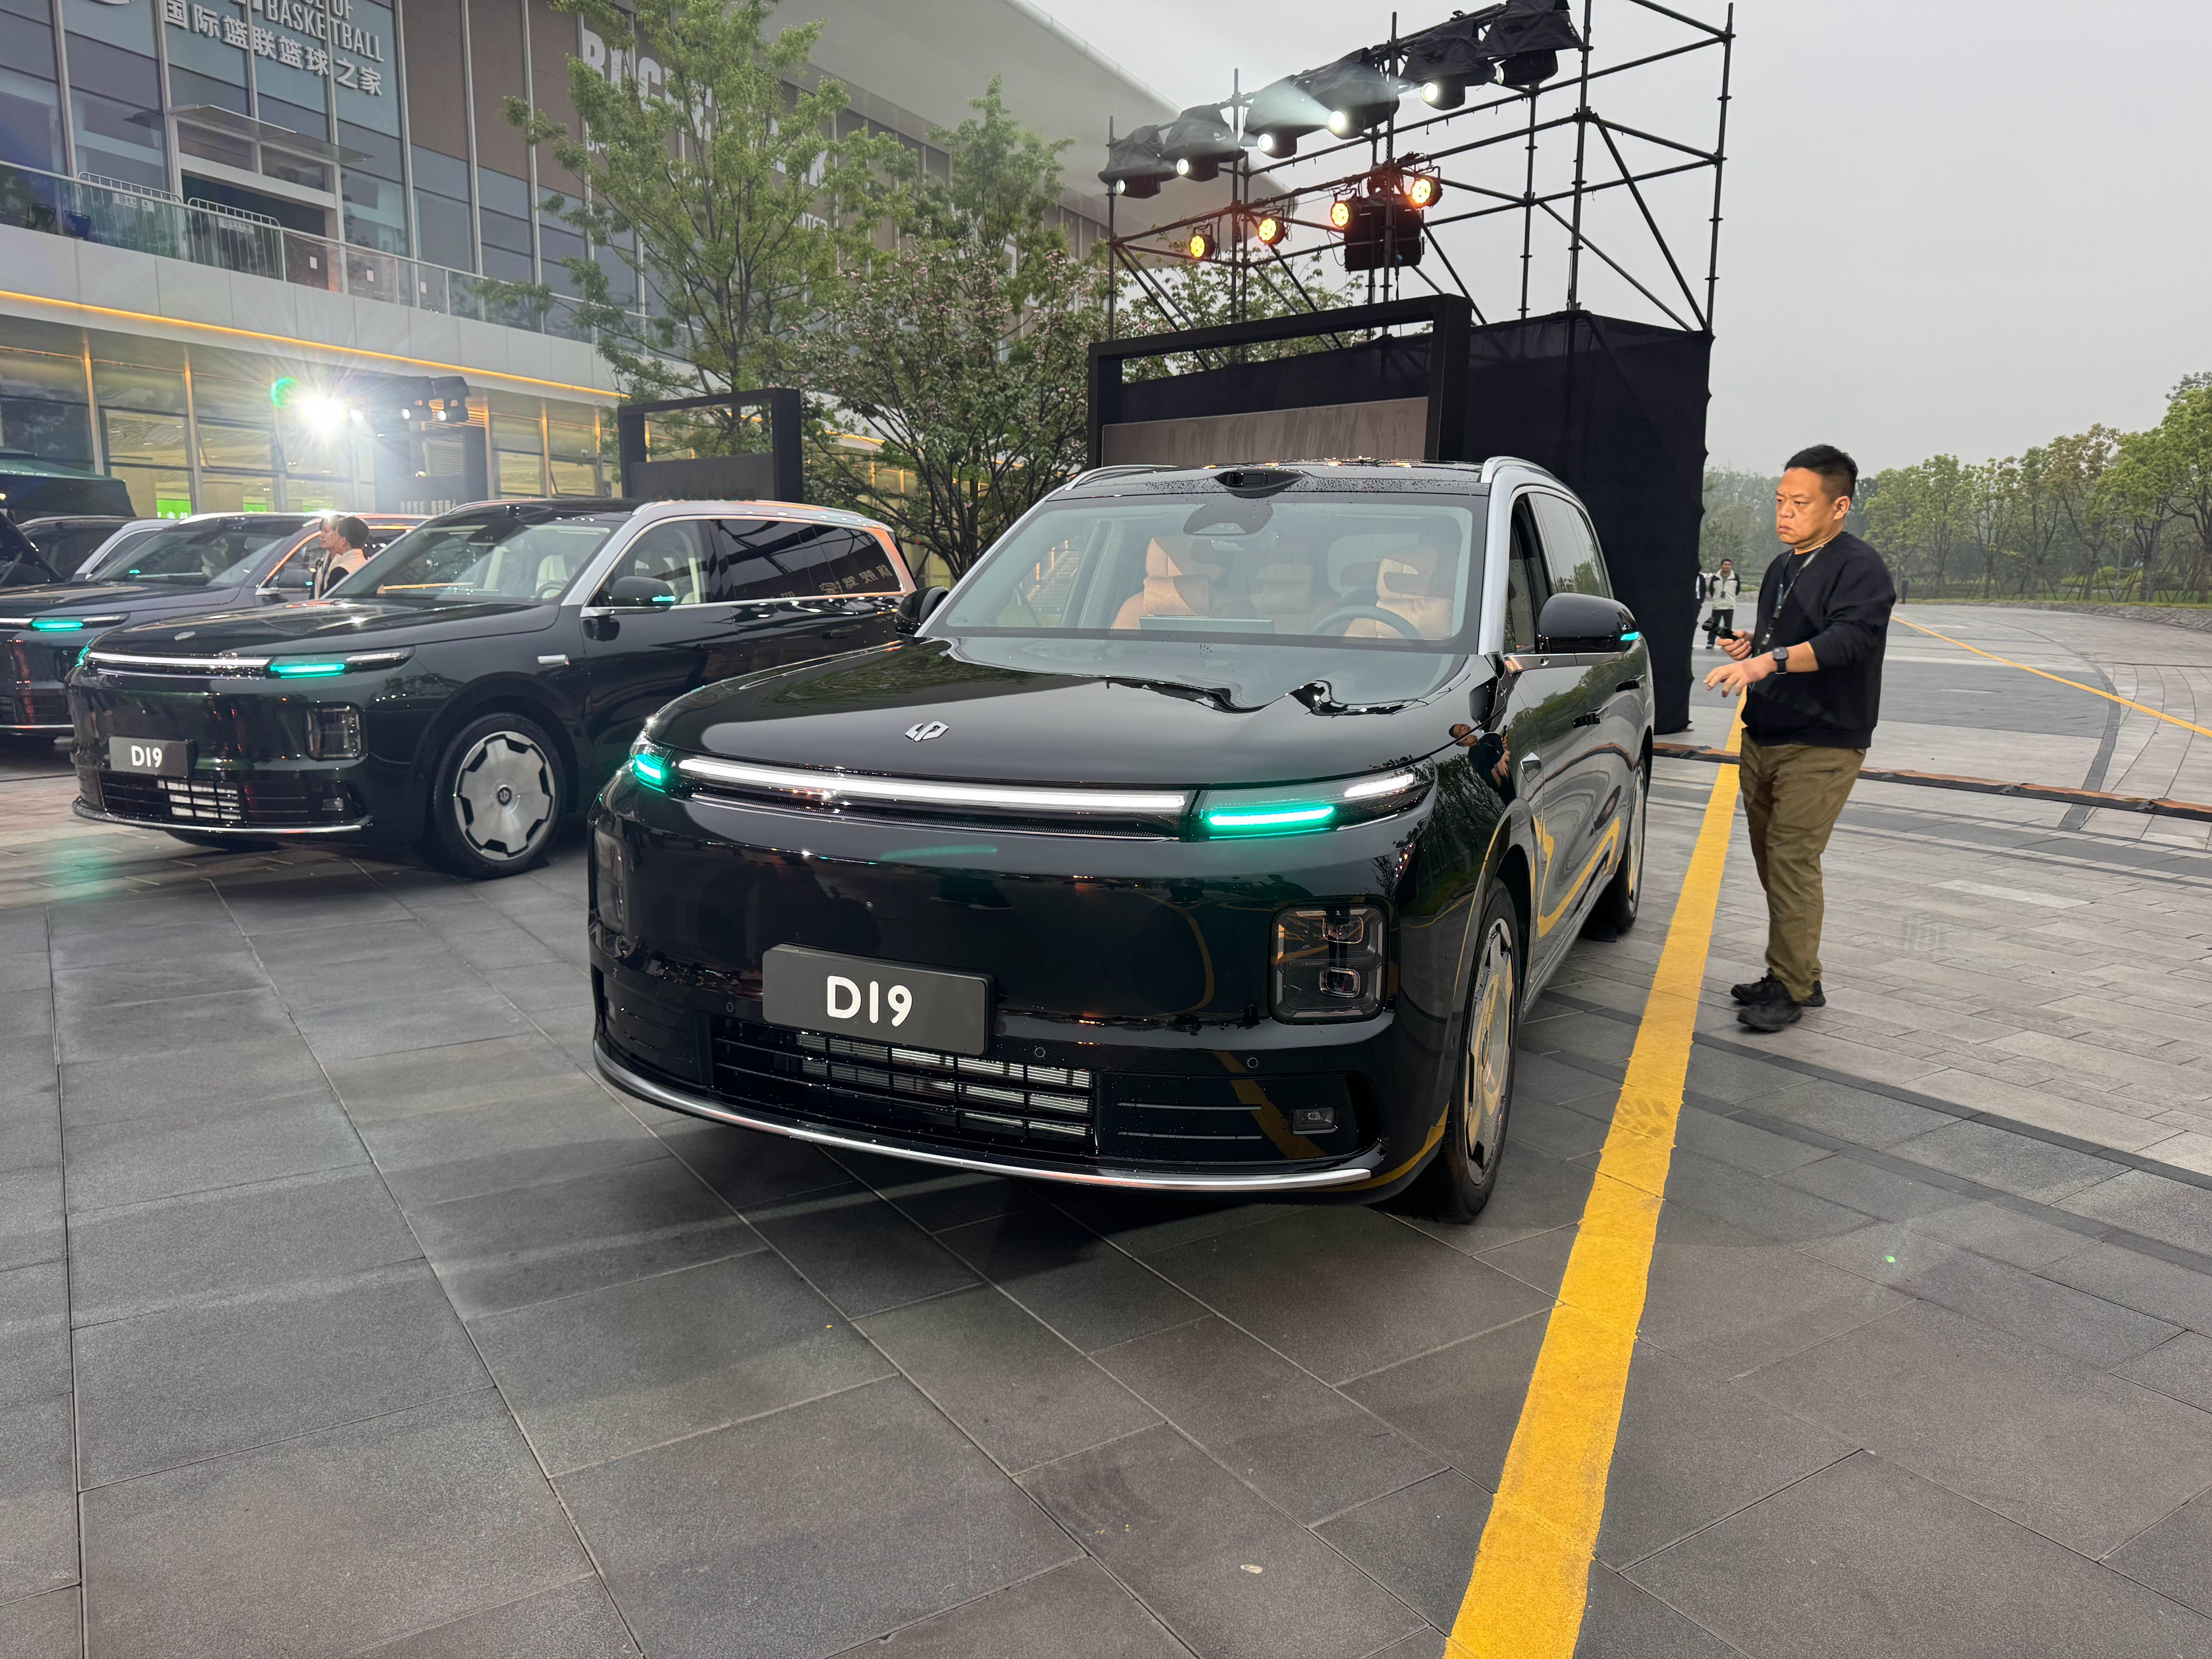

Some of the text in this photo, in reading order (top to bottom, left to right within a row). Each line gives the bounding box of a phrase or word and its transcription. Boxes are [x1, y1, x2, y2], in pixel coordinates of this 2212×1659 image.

[164, 0, 382, 96] 国际篮联篮球之家
[266, 0, 384, 62] BASKETBALL
[131, 745, 162, 768] D19
[827, 975, 912, 1027] D19
